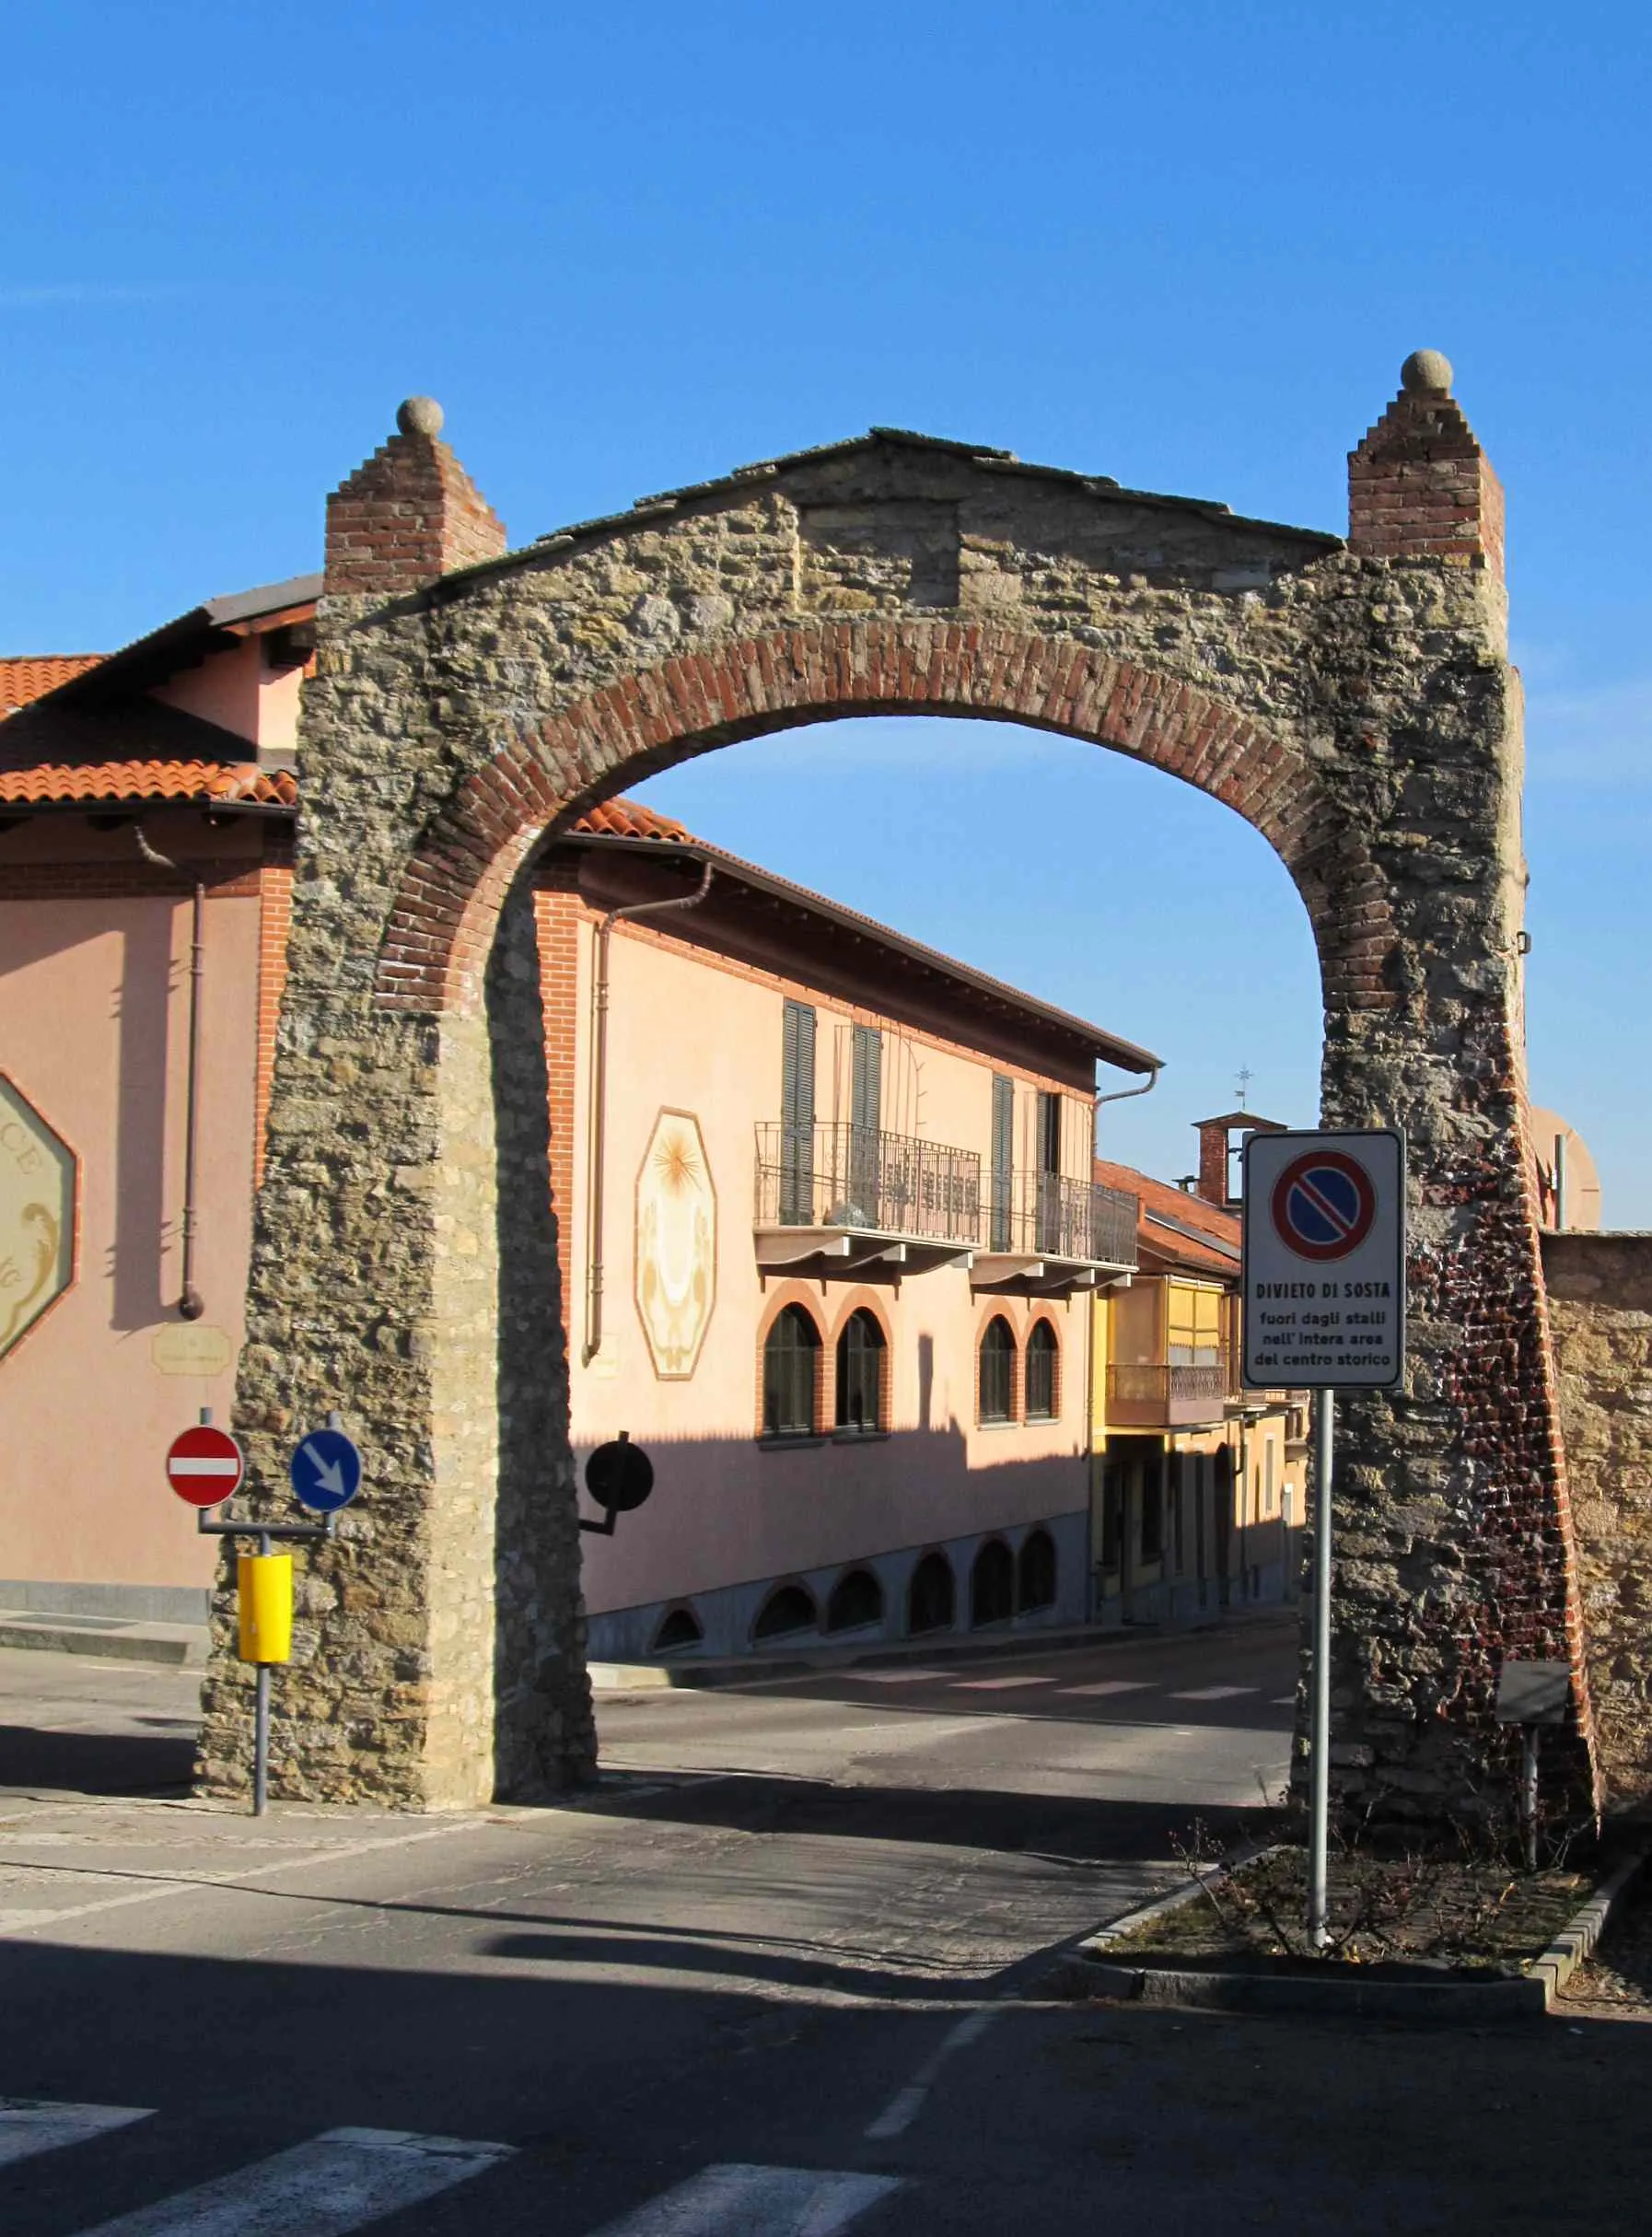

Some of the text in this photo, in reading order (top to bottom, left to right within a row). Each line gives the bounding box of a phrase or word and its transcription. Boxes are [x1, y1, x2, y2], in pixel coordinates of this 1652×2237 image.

[1256, 1282, 1390, 1299] DIVIETO DI SOSTA
[1260, 1311, 1386, 1327] fuori dagli stalli
[1349, 1333, 1384, 1345] area
[1254, 1352, 1390, 1366] del centro storico
